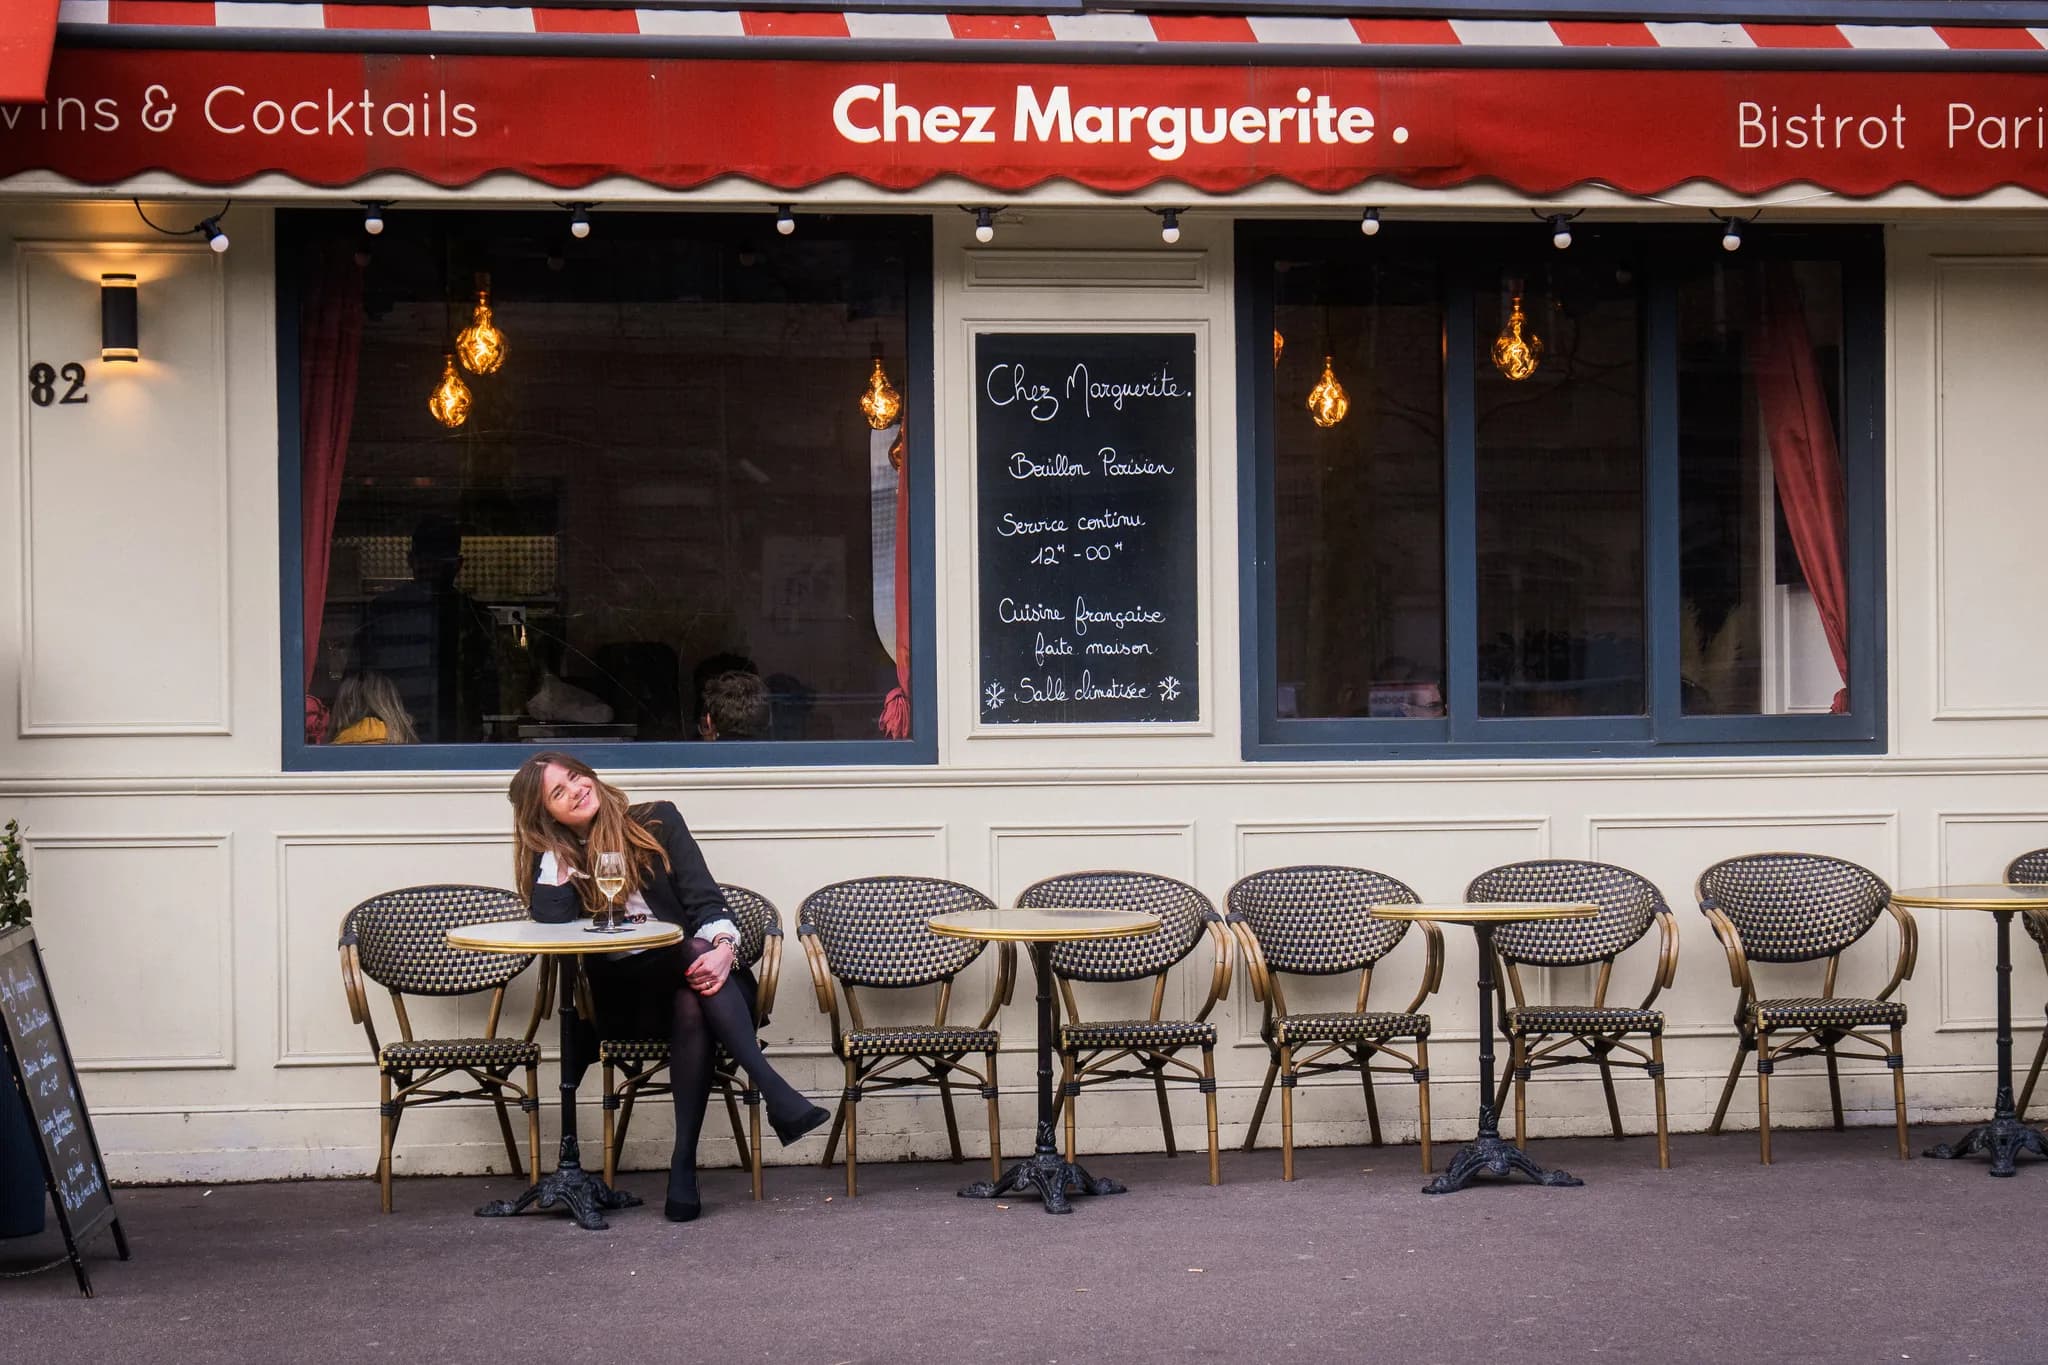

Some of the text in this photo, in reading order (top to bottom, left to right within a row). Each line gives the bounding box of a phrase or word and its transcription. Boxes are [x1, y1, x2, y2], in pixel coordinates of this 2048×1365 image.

[141, 84, 177, 132] &
[204, 86, 478, 138] Cocktails
[832, 82, 996, 144] Chez
[1013, 84, 1375, 161] Marguerite
[1738, 101, 2044, 149] Bistrot Pari
[28, 362, 89, 408] 82
[987, 364, 1059, 421] Chez
[1008, 447, 1175, 479] Bouillon Parisien
[997, 509, 1146, 537] Service continu
[999, 596, 1166, 636] Cuisine française
[1035, 631, 1153, 667] faite maison
[1014, 669, 1152, 704] Salle climatisée
